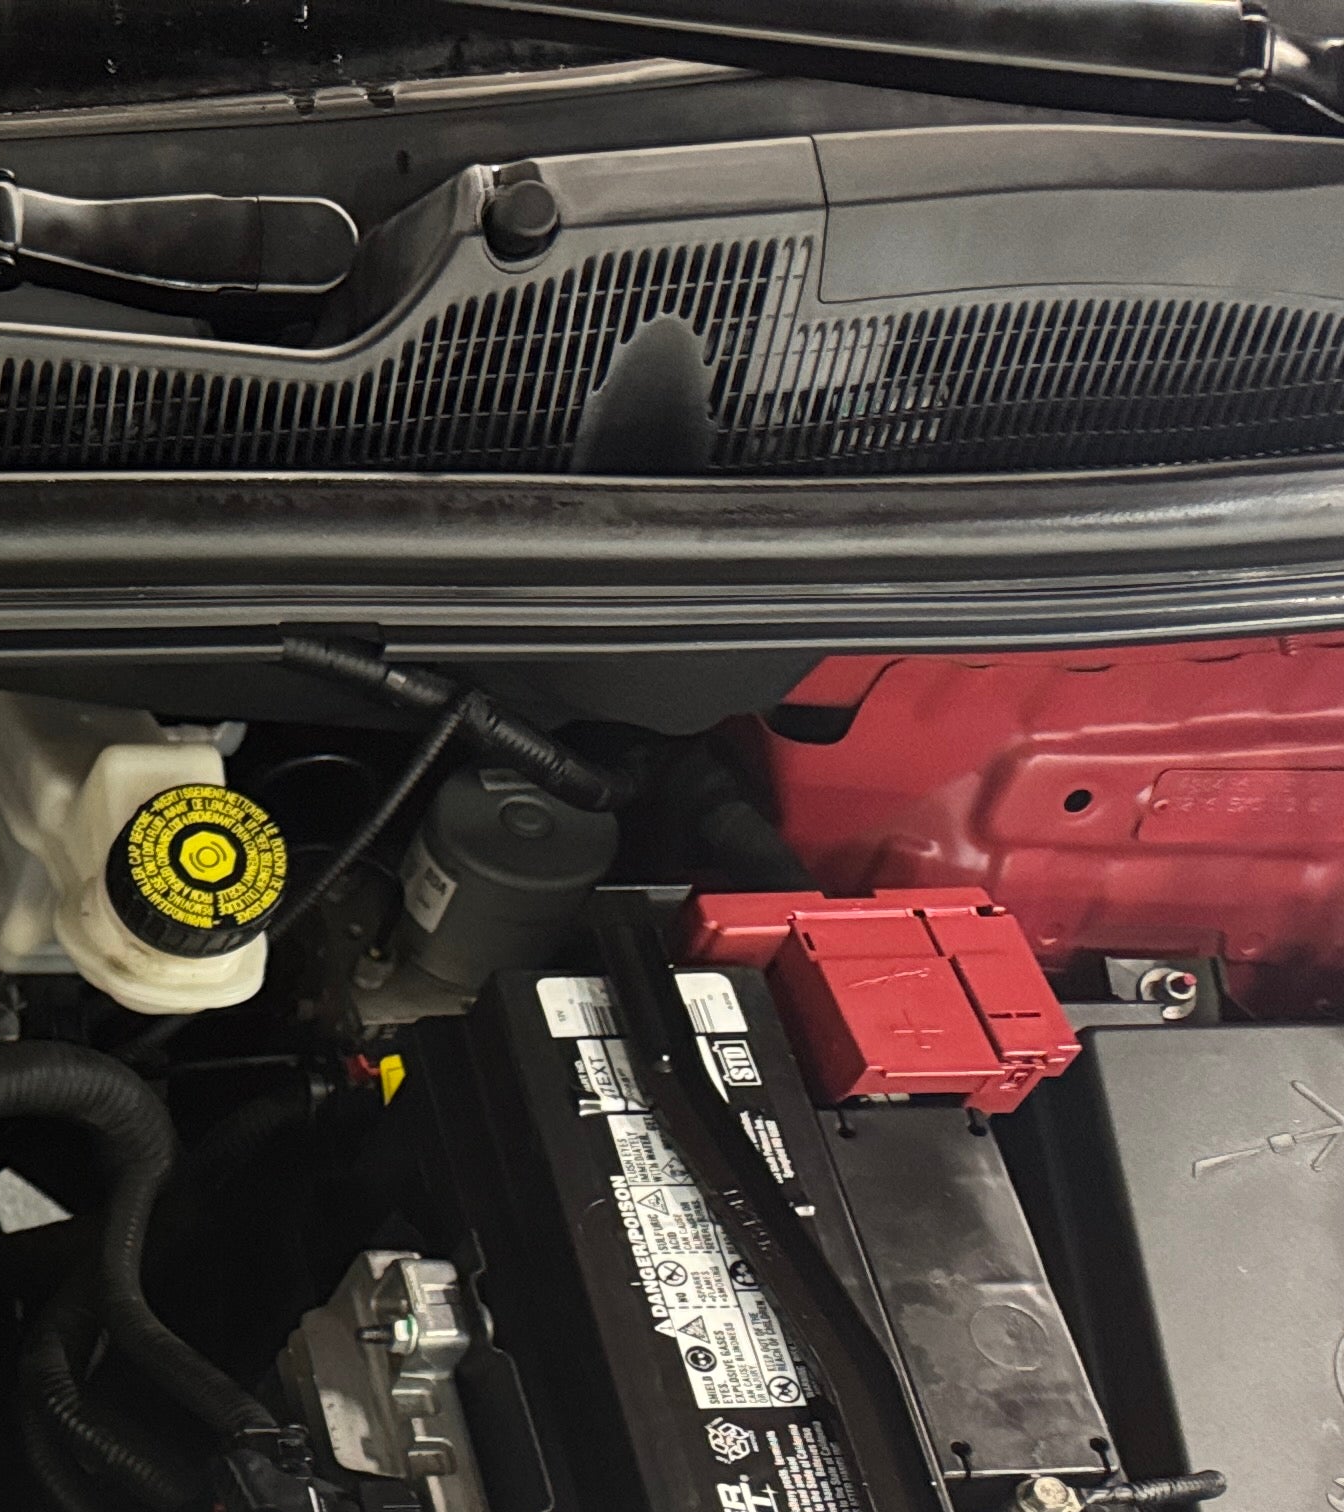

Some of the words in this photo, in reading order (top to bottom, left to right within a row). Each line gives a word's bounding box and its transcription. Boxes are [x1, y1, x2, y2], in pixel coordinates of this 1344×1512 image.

[263, 823, 278, 836] LE
[128, 845, 141, 864] CAP
[150, 875, 168, 893] USE
[182, 886, 191, 897] A
[722, 1045, 754, 1081] STD
[611, 1176, 667, 1317] DANGER/POISON
[723, 1360, 746, 1403] EXPLOSIVE
